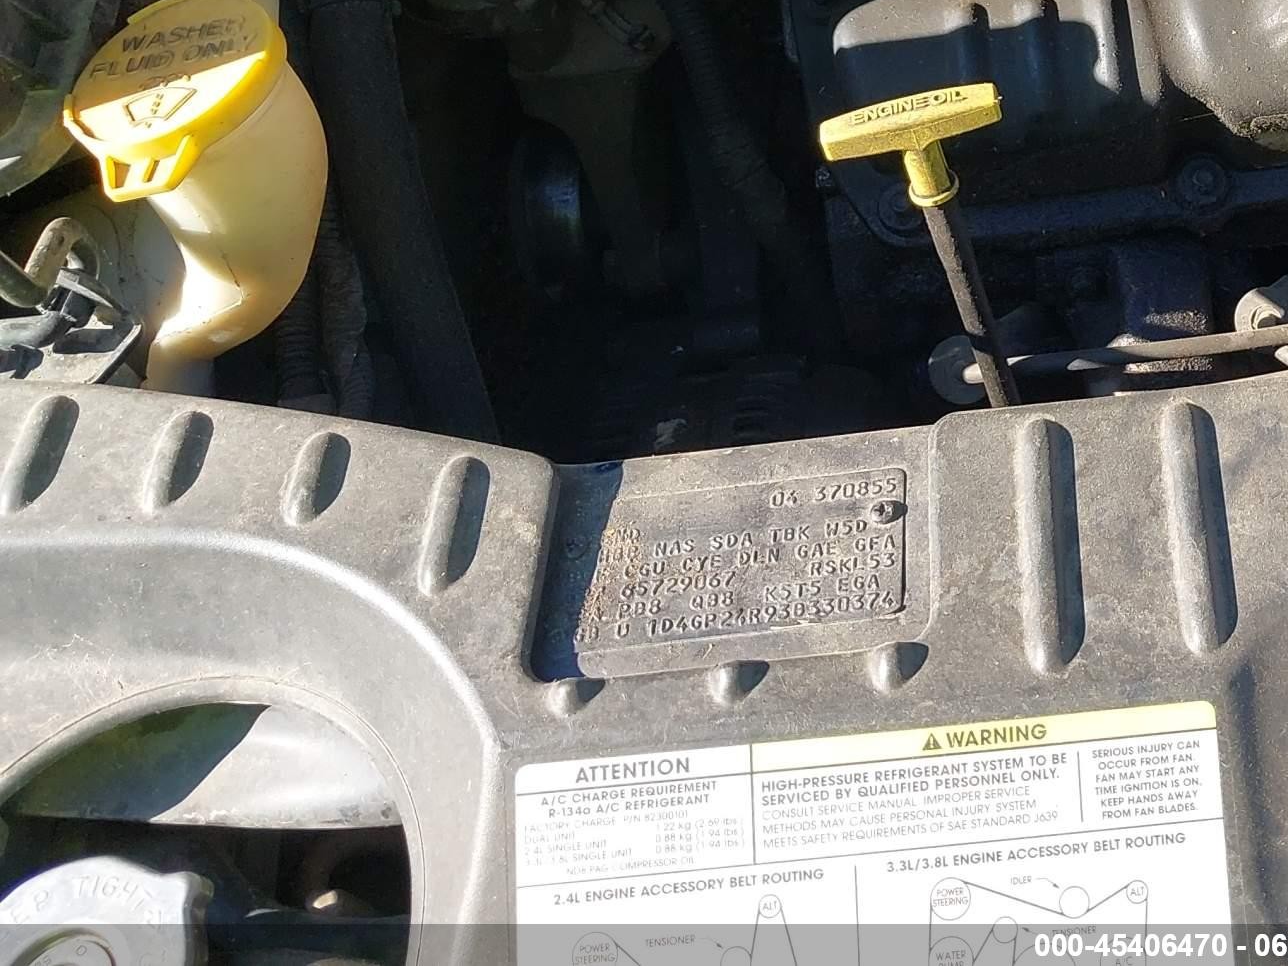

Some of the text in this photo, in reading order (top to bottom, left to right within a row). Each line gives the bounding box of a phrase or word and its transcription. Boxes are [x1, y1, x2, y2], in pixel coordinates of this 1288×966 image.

[122, 17, 246, 53] WASHER
[90, 35, 258, 79] FLUID ONLY
[814, 477, 897, 502] 370855
[654, 538, 695, 558] NAS
[710, 532, 753, 551] SDA
[769, 525, 811, 543] TBK
[682, 554, 722, 573] CYE
[797, 540, 838, 559] GAE
[854, 534, 896, 552] GFA
[809, 552, 896, 577] RSKL53
[837, 574, 881, 594] EGA
[946, 724, 1047, 748] WARNING
[1092, 740, 1200, 757] SERIOUS INJURY CAN
[575, 757, 690, 782] ATTENTION
[1098, 756, 1169, 769] OCCUR FROM
[761, 754, 1067, 792] HIGH-PRESSURE REFRIGERANT SYSTEM TO BE
[1095, 765, 1200, 782] FAN MAY START ANY
[541, 781, 717, 806] A/C CHARGE REQUIREMENT
[761, 768, 1060, 806] SERVICED BY QUALIFIED PERSONNEL ONLY.
[1095, 777, 1203, 794] TIME IGNITION IS ON.
[596, 802, 621, 813] A/C
[625, 794, 710, 810] REFRIGERANT
[762, 807, 813, 820] CONSULT
[818, 802, 864, 814] SERVICE
[924, 791, 981, 804] IMPROPER
[984, 786, 1030, 798] SERVICE
[1100, 790, 1198, 806] KEEP HANDS AWAY
[762, 821, 816, 834] METHODS
[820, 818, 844, 829] MAY
[849, 814, 885, 826] CAUSE
[889, 808, 948, 822] PERSONAL
[995, 799, 1036, 812] SYSTEM
[1101, 809, 1131, 819] FROM
[1134, 807, 1154, 816] FAN
[763, 812, 1058, 849] MEETS SAFETY REQUIREMENTS OF SAE STANDARD J639
[887, 833, 1185, 872] 3.3L/3.8L ENGINE ACCESSORY BELT ROUTING
[554, 869, 824, 905] 2.4L ENGINE ACCESSORY BELT ROUTING
[1010, 876, 1032, 885] IDLER
[936, 887, 963, 897] POWER
[1130, 887, 1145, 896] ALT
[761, 901, 778, 911] ALT
[932, 896, 968, 908] STEERING
[579, 943, 610, 954] POWER
[645, 935, 695, 948] TENSIONER
[575, 952, 616, 965] STEERING
[935, 949, 967, 961] WATER
